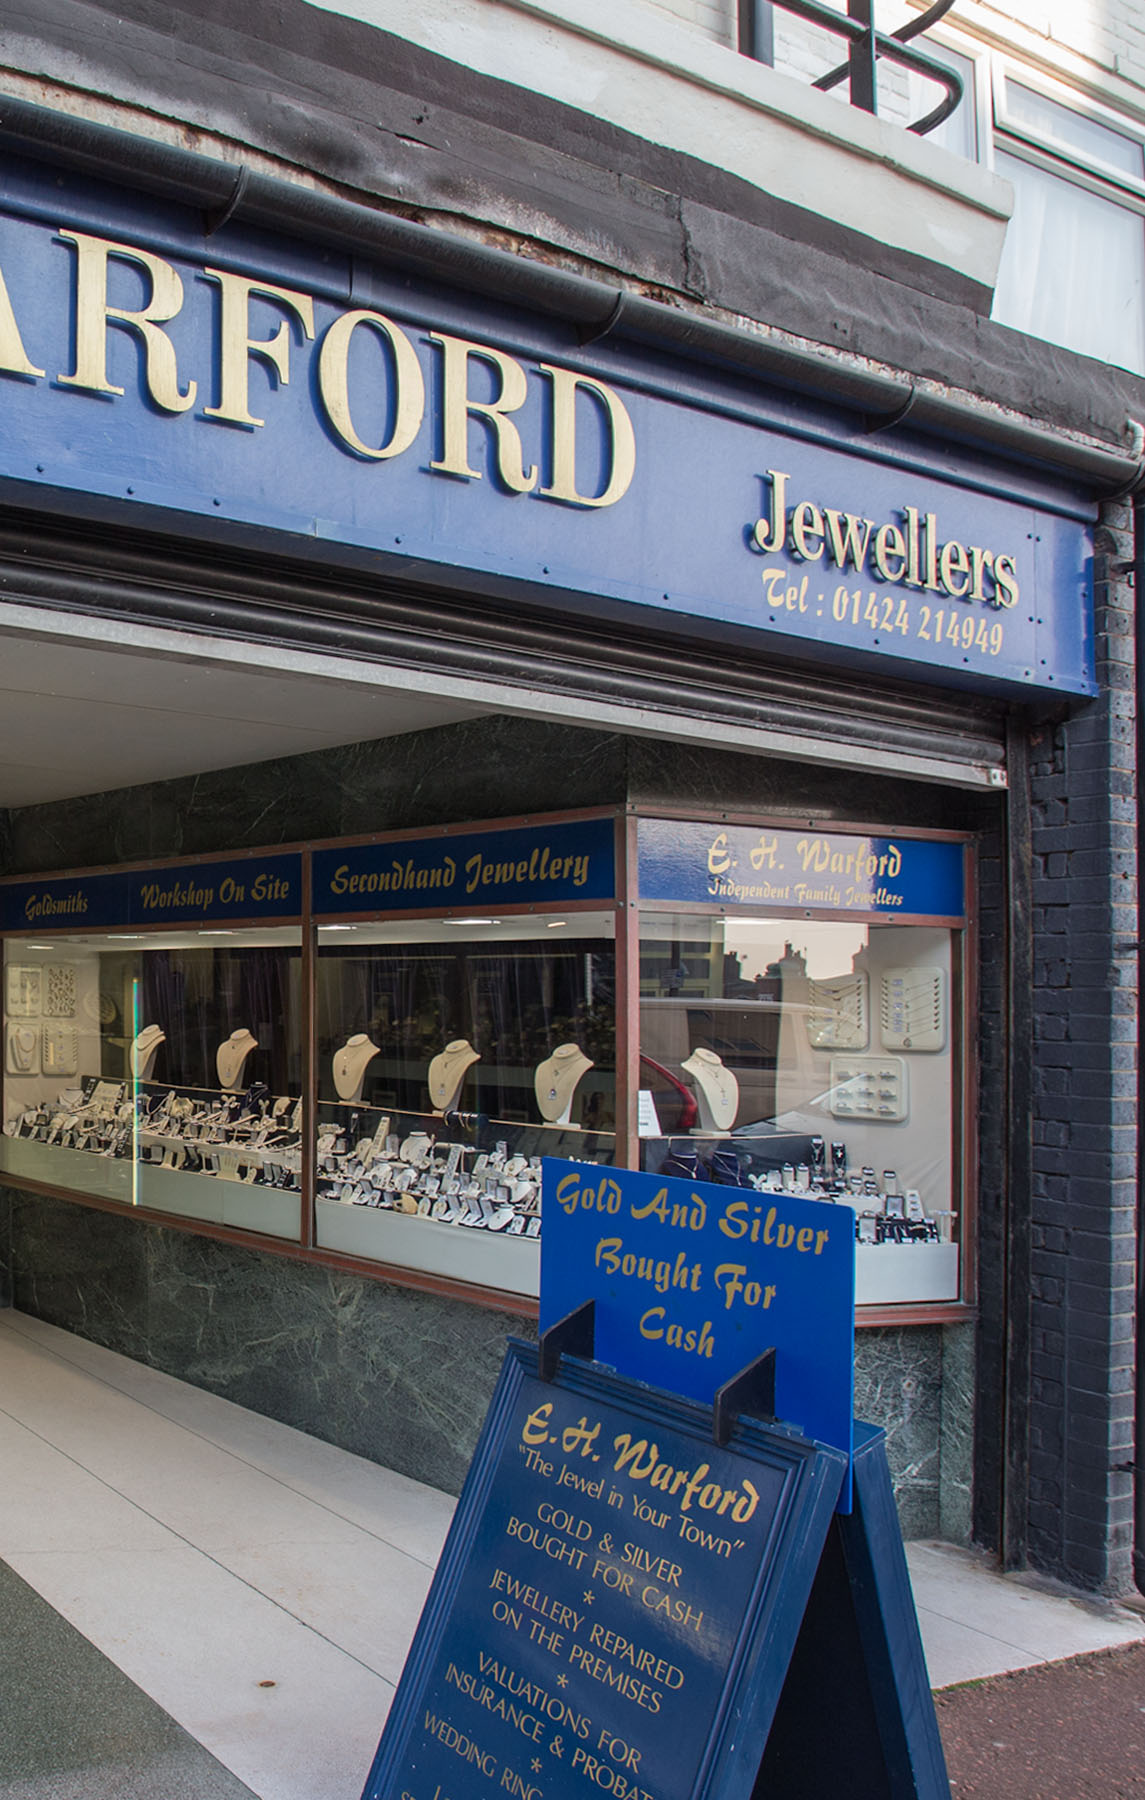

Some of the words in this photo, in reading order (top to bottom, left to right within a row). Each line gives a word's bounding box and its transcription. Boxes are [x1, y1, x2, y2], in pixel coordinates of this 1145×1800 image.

[754, 469, 1020, 609] Jewellers
[832, 586, 909, 637] 01424
[916, 606, 1003, 656] 214949
[141, 881, 214, 911] Workshop
[219, 877, 247, 904] On
[250, 874, 290, 901] Site
[330, 856, 458, 896] Secondhand
[465, 846, 591, 893] Jewellery
[707, 877, 790, 901] Independent
[793, 883, 841, 907] Family
[844, 886, 905, 907] Jewellers
[796, 839, 902, 883] Warford
[25, 890, 88, 921] Goldsmiths
[556, 1173, 623, 1215] Gold
[630, 1188, 707, 1232] And
[718, 1201, 829, 1256] Silver
[595, 1237, 703, 1293] Bought
[715, 1263, 777, 1309] For
[639, 1306, 715, 1358] Cash
[556, 1464, 605, 1501] Jewel
[608, 1485, 624, 1510] in
[633, 1498, 672, 1529] Your
[614, 1433, 760, 1524] Warford
[506, 1516, 586, 1571] BOUGHT
[592, 1561, 634, 1597] FOR
[640, 1584, 704, 1632] CASH
[537, 1501, 593, 1541] GOLD
[598, 1532, 614, 1554] &
[620, 1543, 683, 1588] SILVER
[489, 1568, 585, 1634] JEWELLERY
[589, 1621, 685, 1690] REPAIRED
[492, 1600, 523, 1630] ON
[530, 1620, 563, 1656] THE
[569, 1644, 664, 1715] PREMISES
[423, 1709, 497, 1778] WEDDING
[444, 1662, 548, 1743] INSURANCE
[550, 1734, 567, 1759] &
[478, 1651, 592, 1740] VALUATIONS
[597, 1729, 644, 1775] FOR
